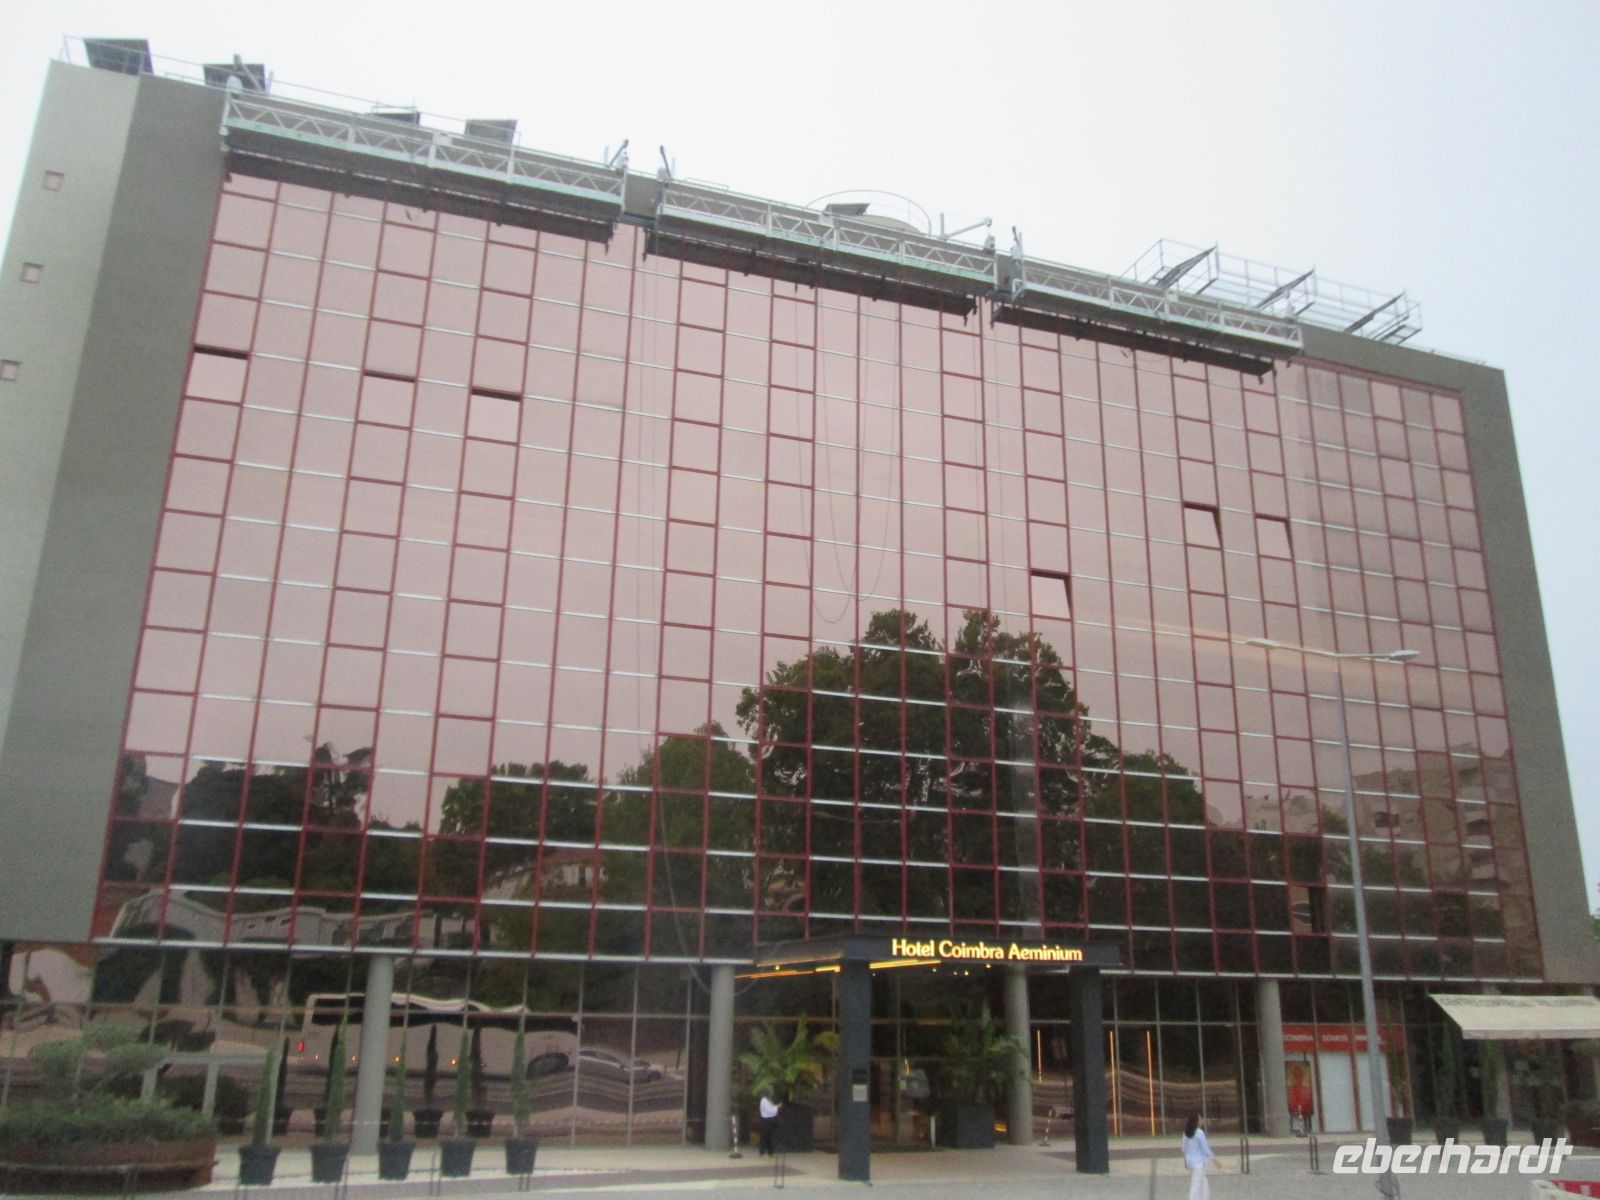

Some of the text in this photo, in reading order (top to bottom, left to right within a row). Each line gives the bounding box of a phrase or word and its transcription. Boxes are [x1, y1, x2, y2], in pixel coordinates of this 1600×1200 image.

[892, 938, 1083, 961] Hotel Coimbra Aeminium
